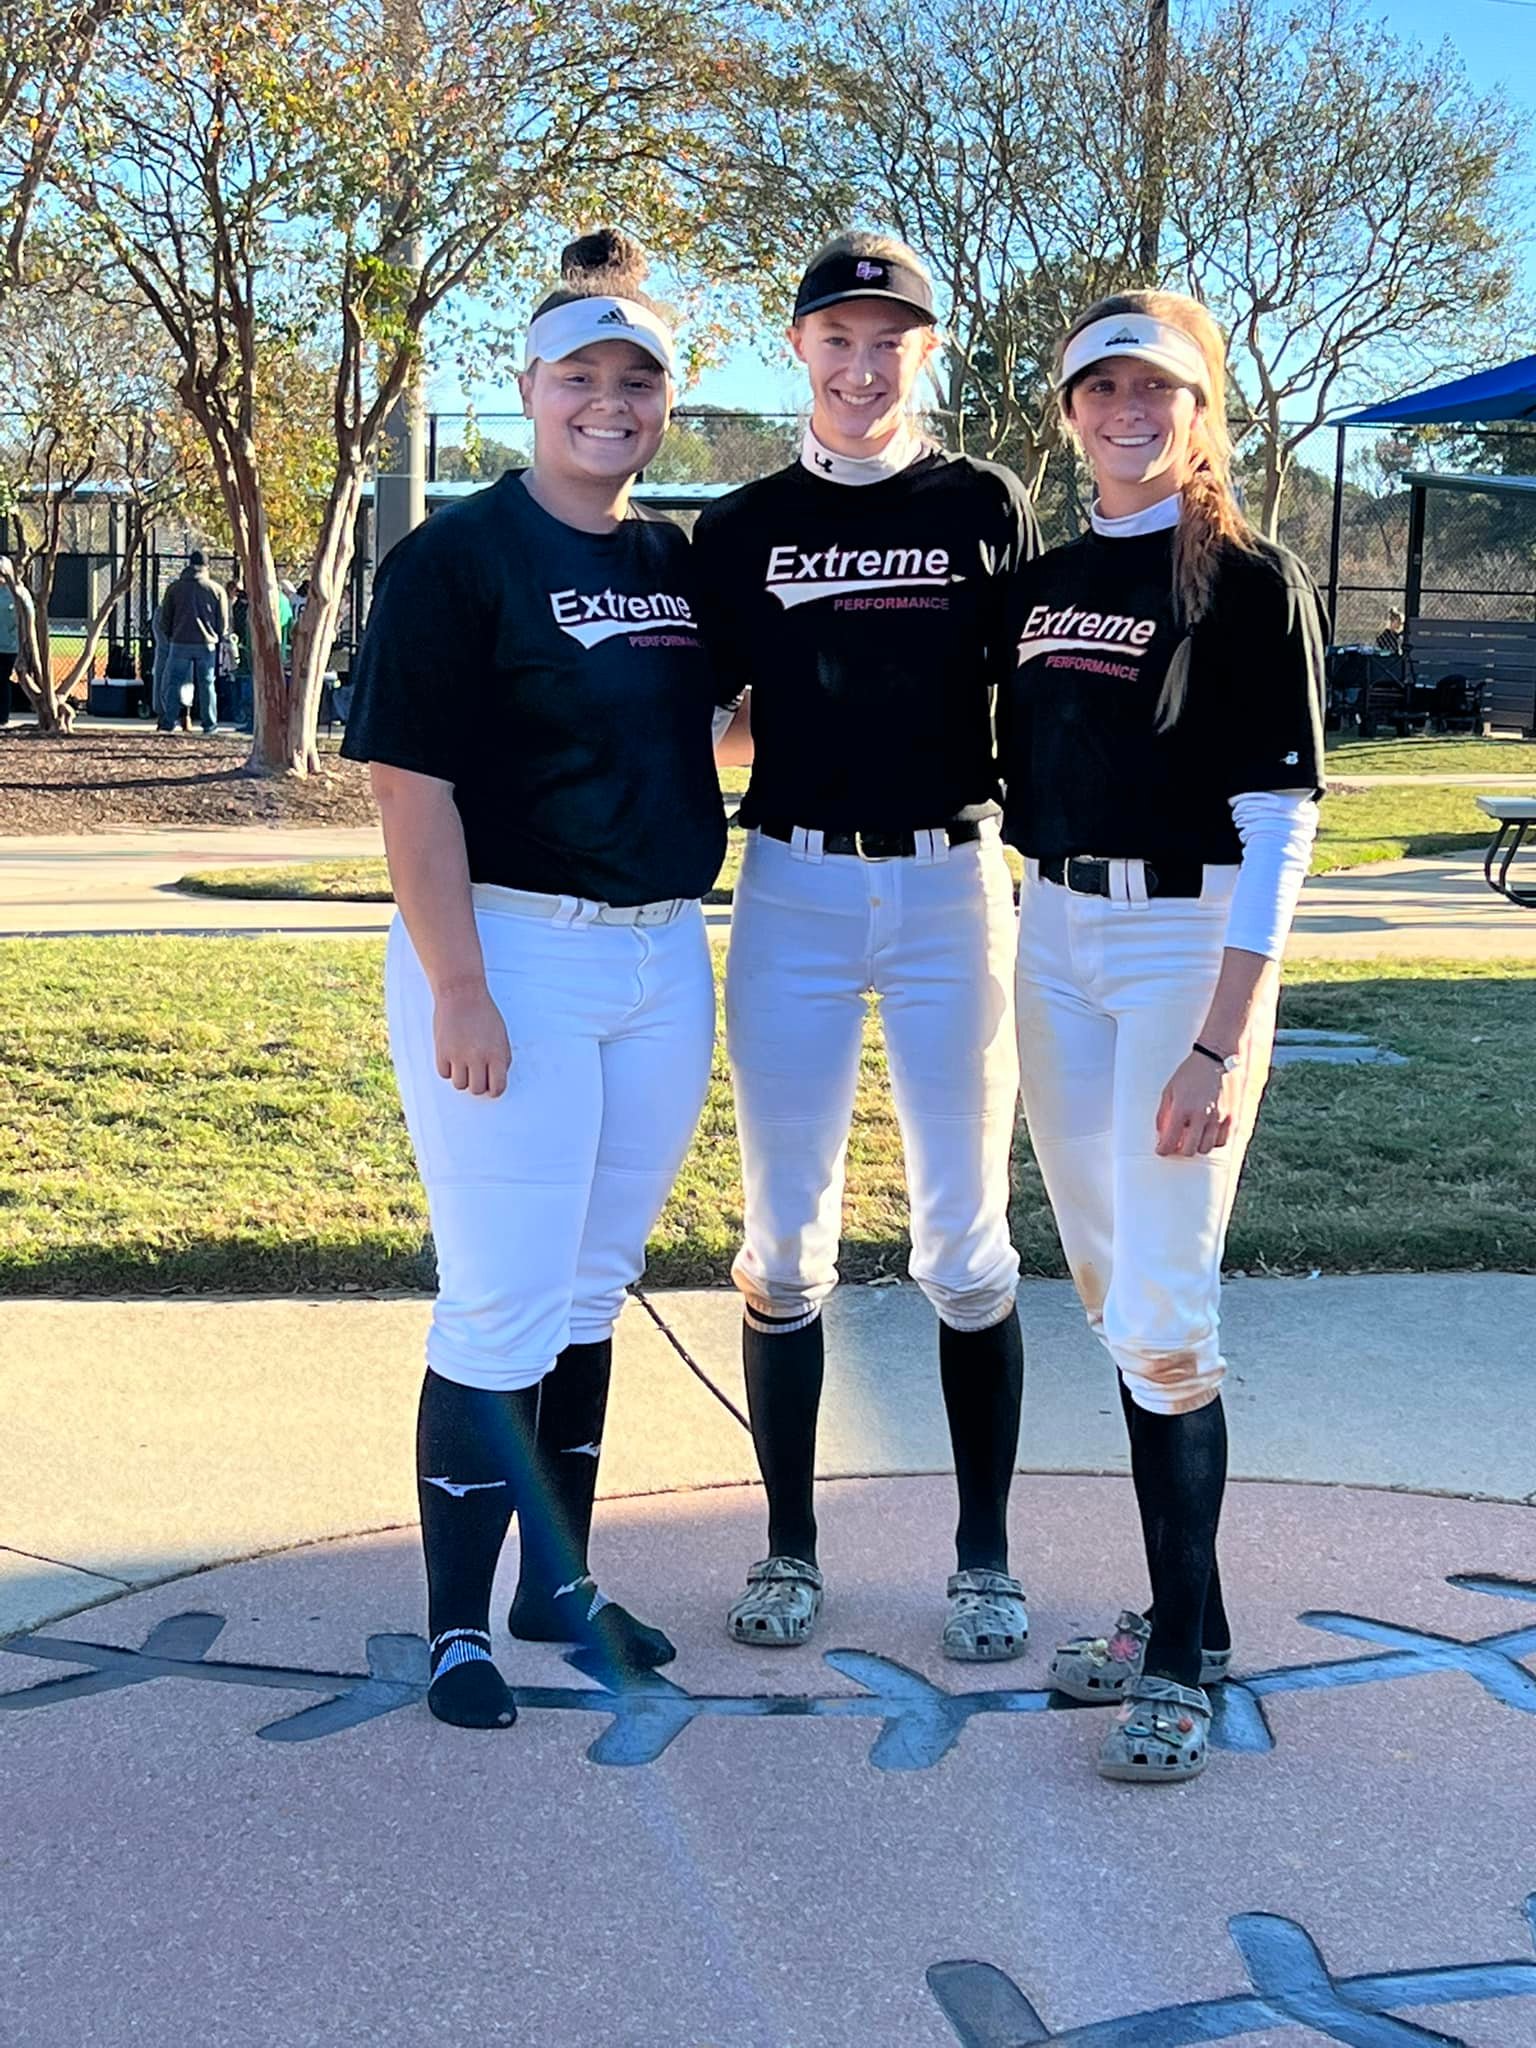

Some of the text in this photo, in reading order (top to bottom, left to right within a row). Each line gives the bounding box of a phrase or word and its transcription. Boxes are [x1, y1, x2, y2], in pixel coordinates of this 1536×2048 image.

[765, 543, 949, 582] Extreme
[549, 587, 692, 624] Extreme
[833, 597, 950, 612] PERFORMANCE
[1020, 603, 1157, 645] Extreme
[1045, 655, 1140, 682] PERFORMANCE
